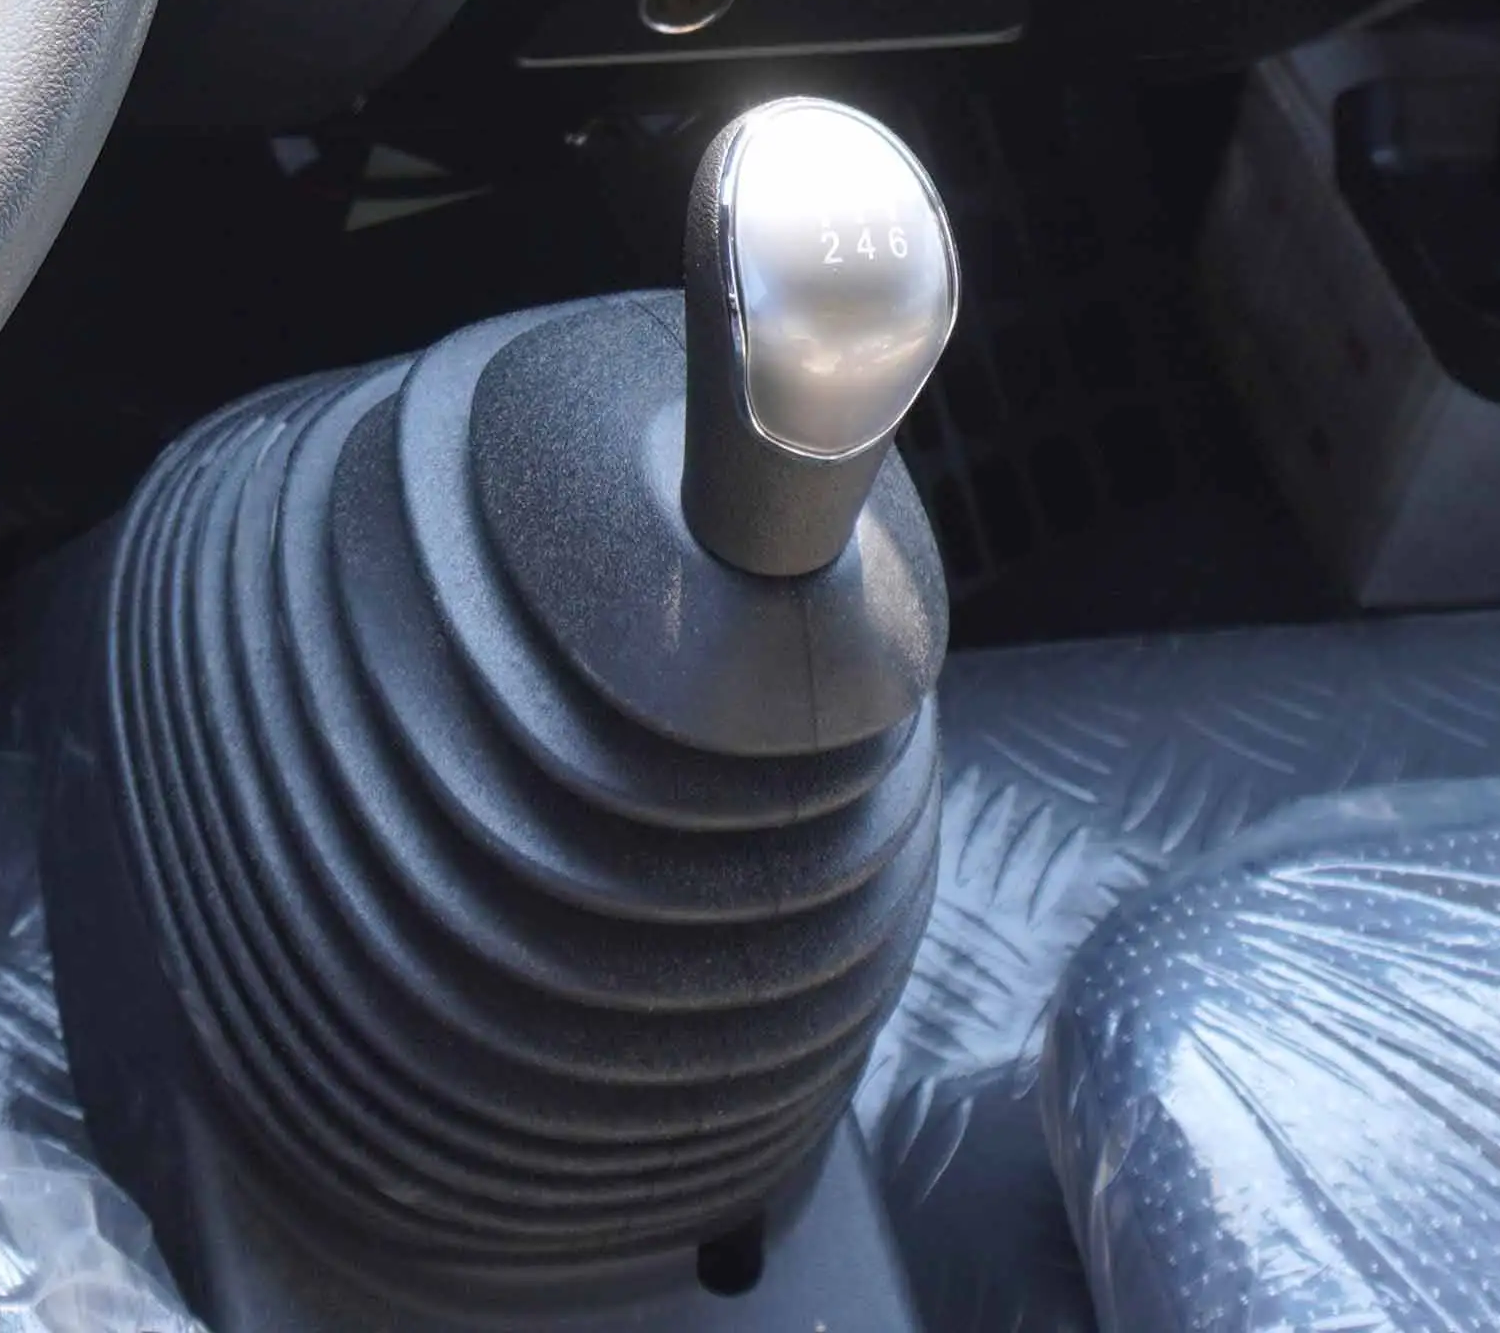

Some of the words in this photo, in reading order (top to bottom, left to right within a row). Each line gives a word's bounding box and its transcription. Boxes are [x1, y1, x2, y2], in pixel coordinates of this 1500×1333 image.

[821, 230, 844, 265] 2
[856, 226, 876, 261] 4
[887, 226, 909, 259] 6
